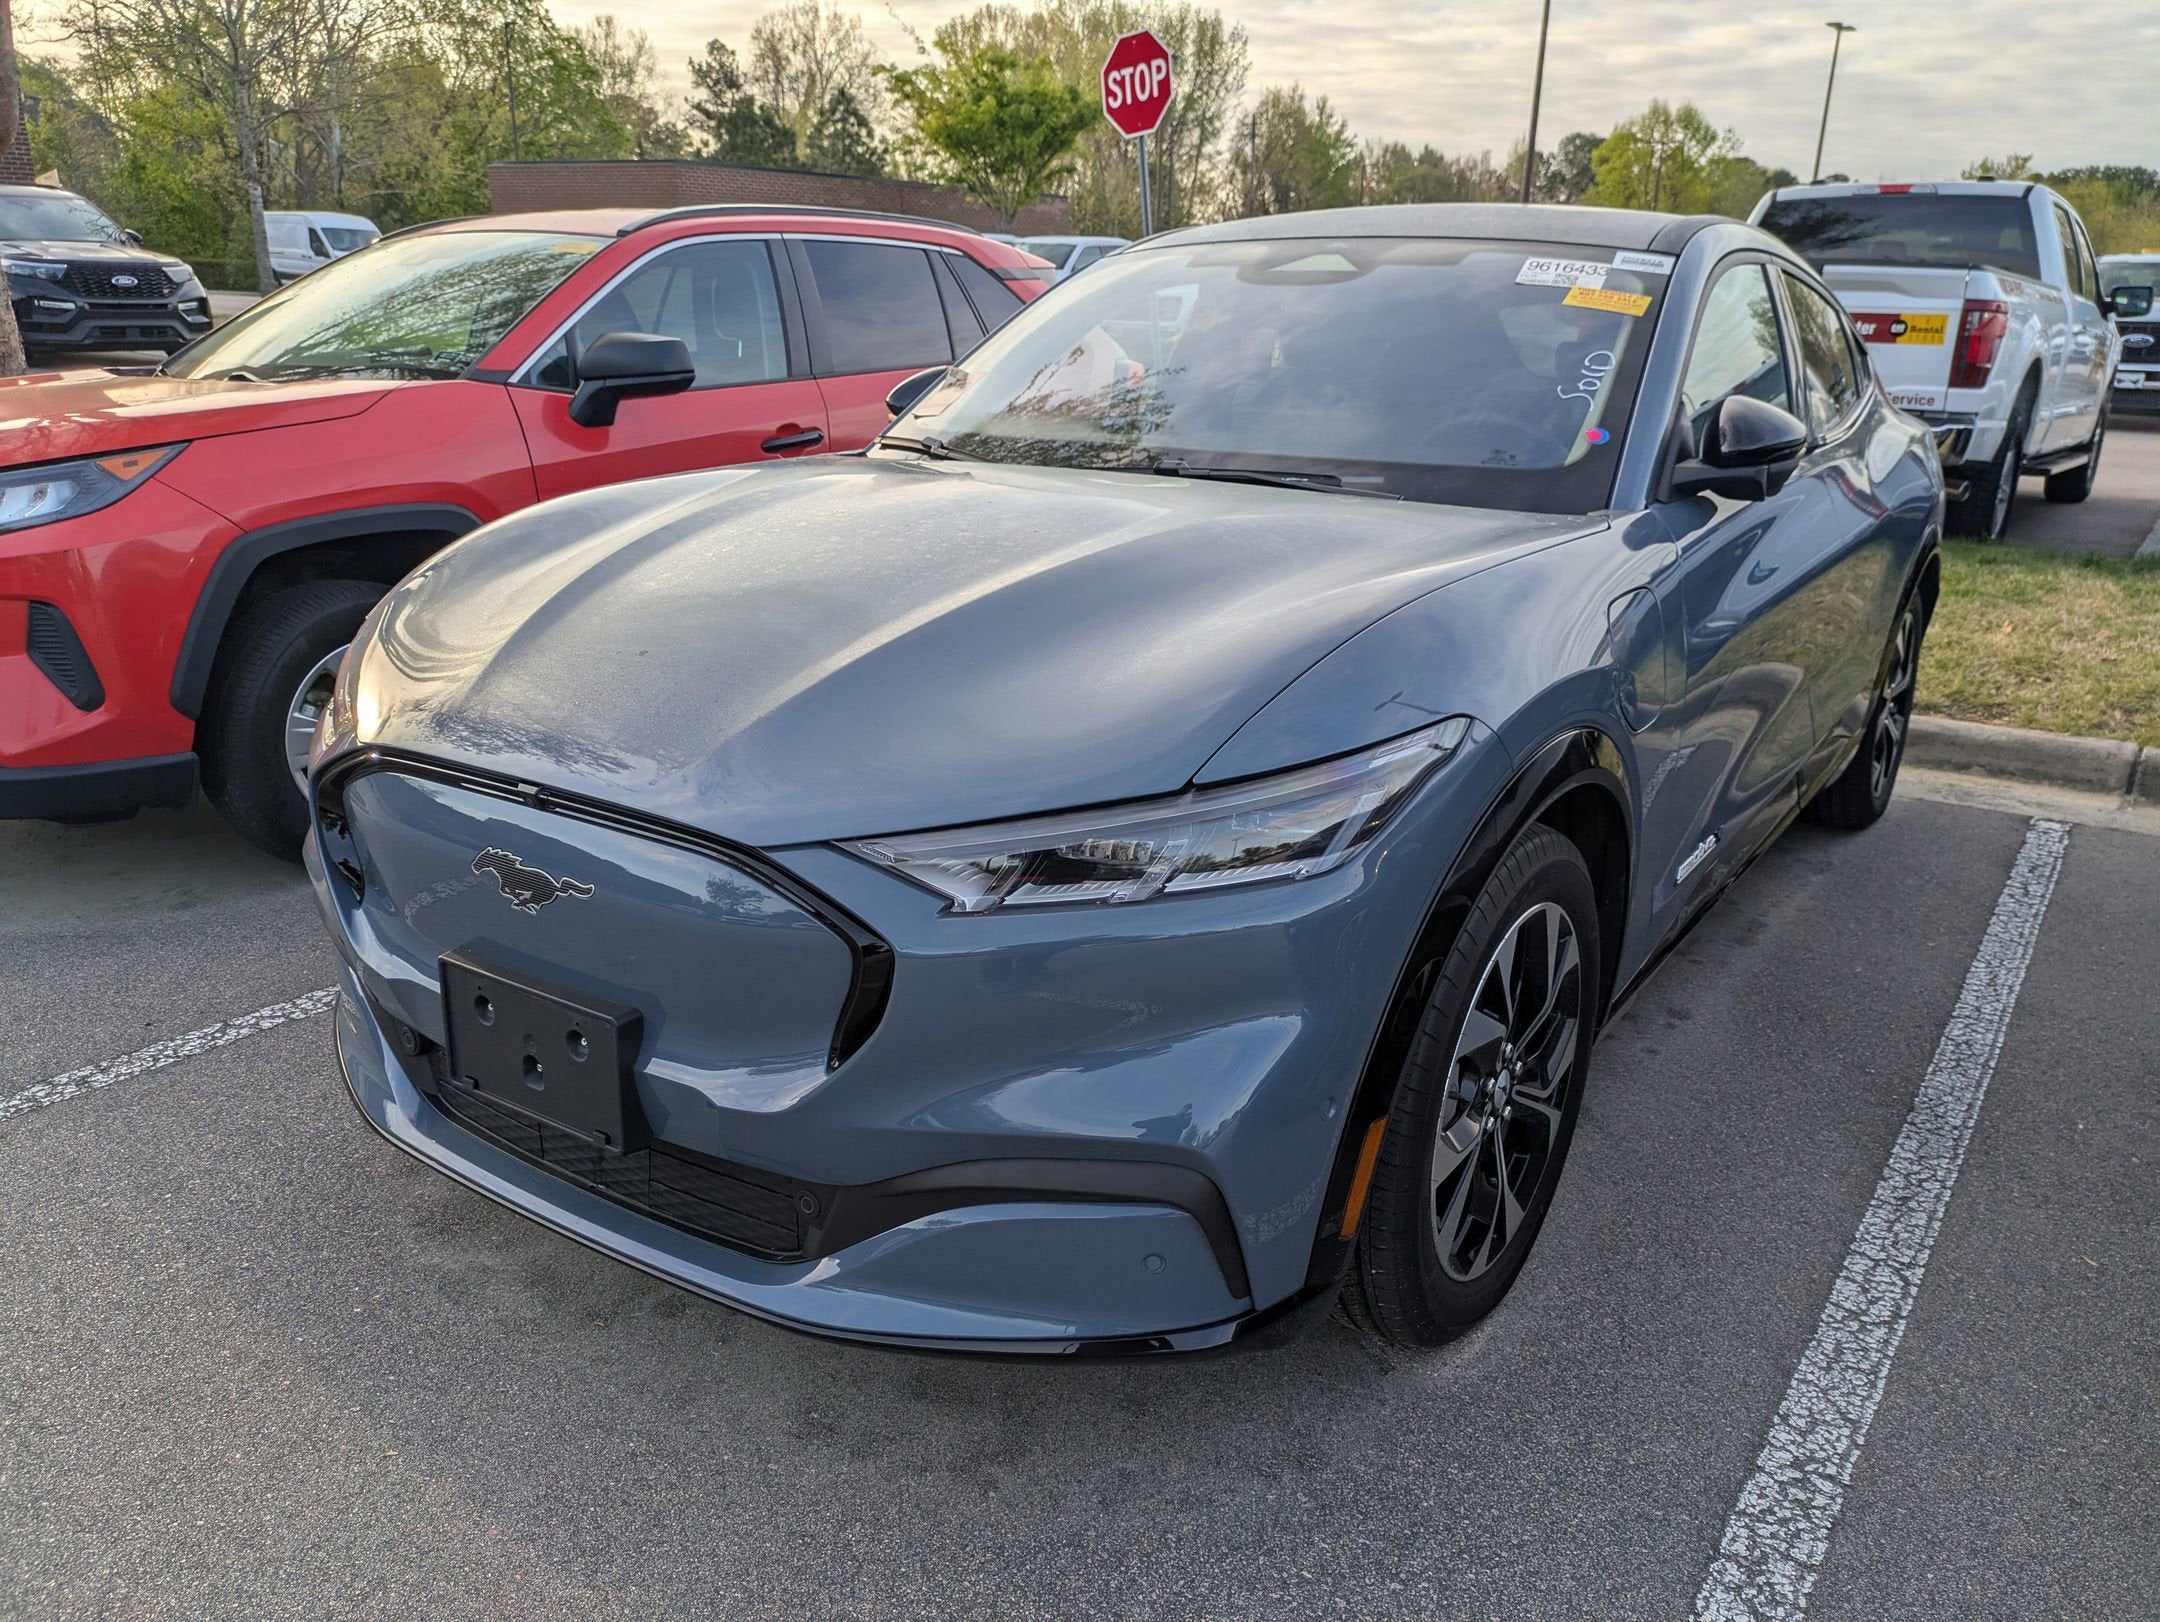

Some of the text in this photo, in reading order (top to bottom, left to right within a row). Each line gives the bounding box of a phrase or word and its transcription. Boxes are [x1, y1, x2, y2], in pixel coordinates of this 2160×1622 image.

[1107, 57, 1167, 109] STOP
[1527, 260, 1609, 277] 9616433
[1910, 325, 1944, 334] Rental
[1887, 392, 1936, 406] ervice
